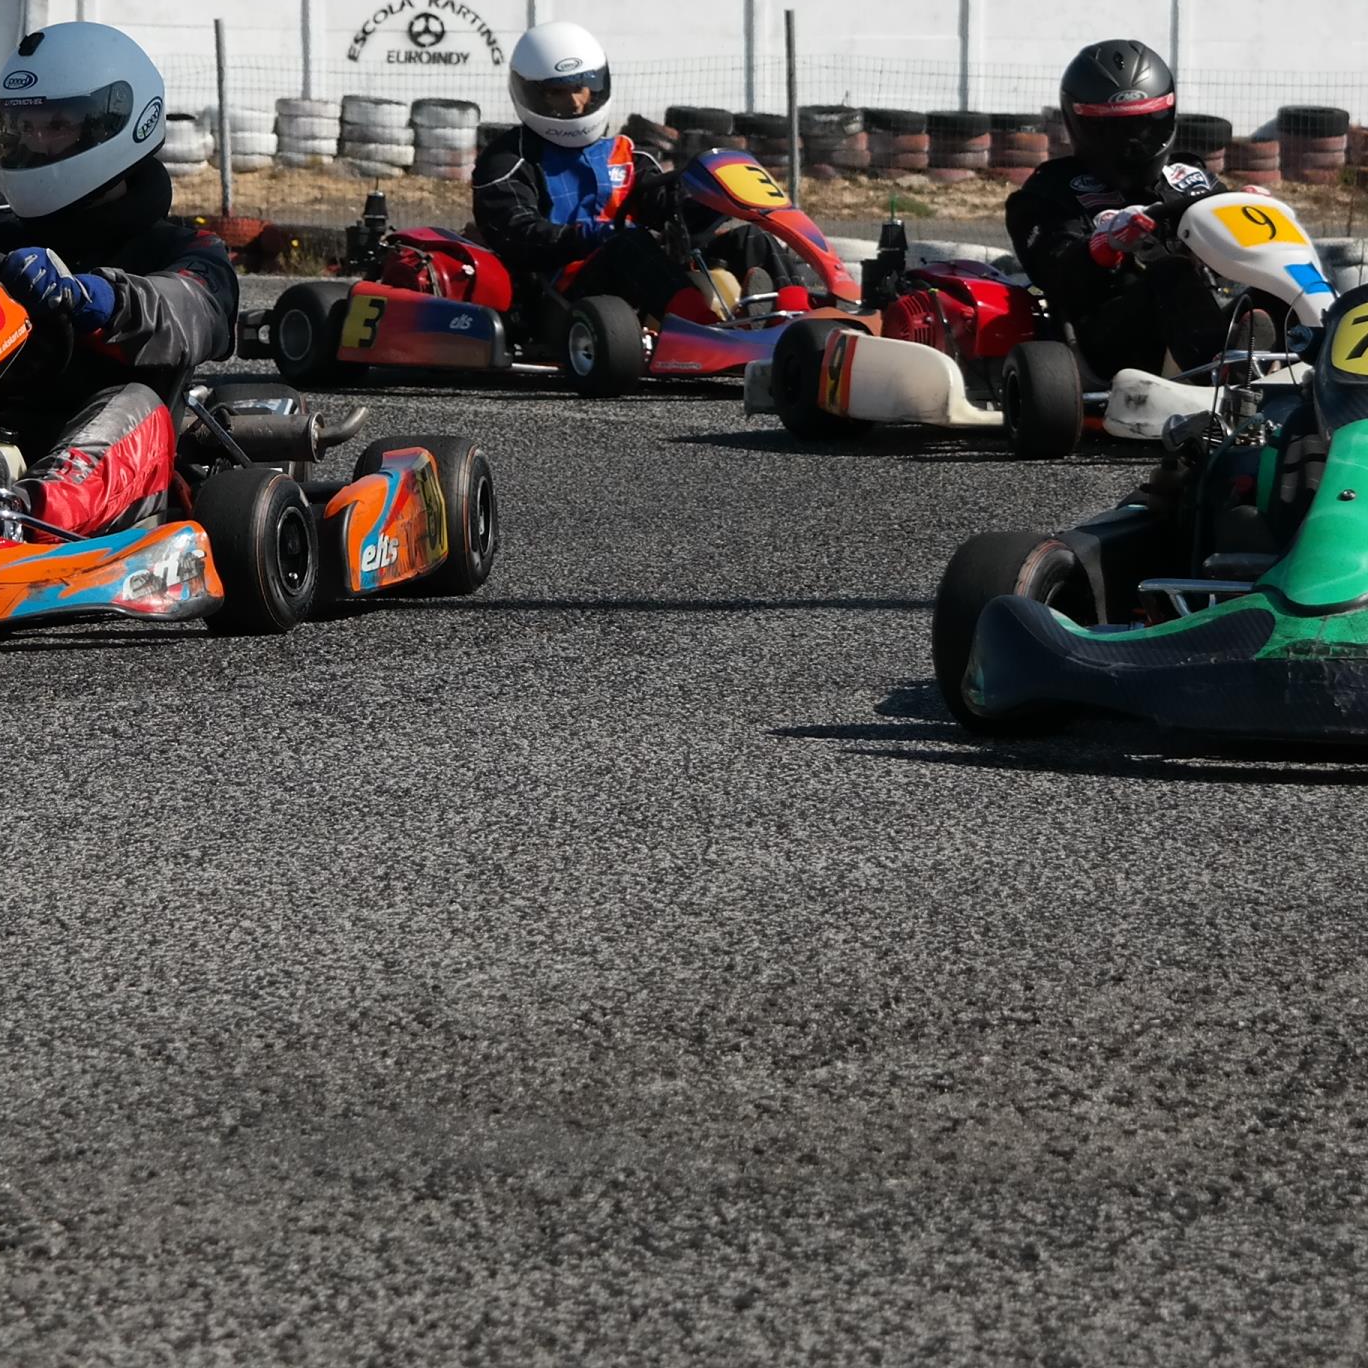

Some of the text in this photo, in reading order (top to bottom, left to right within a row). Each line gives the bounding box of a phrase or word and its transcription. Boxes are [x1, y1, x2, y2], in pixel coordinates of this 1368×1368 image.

[386, 49, 471, 65] EUROINDY
[743, 164, 786, 199] 3
[1241, 205, 1277, 240] 9
[357, 298, 386, 349] 3
